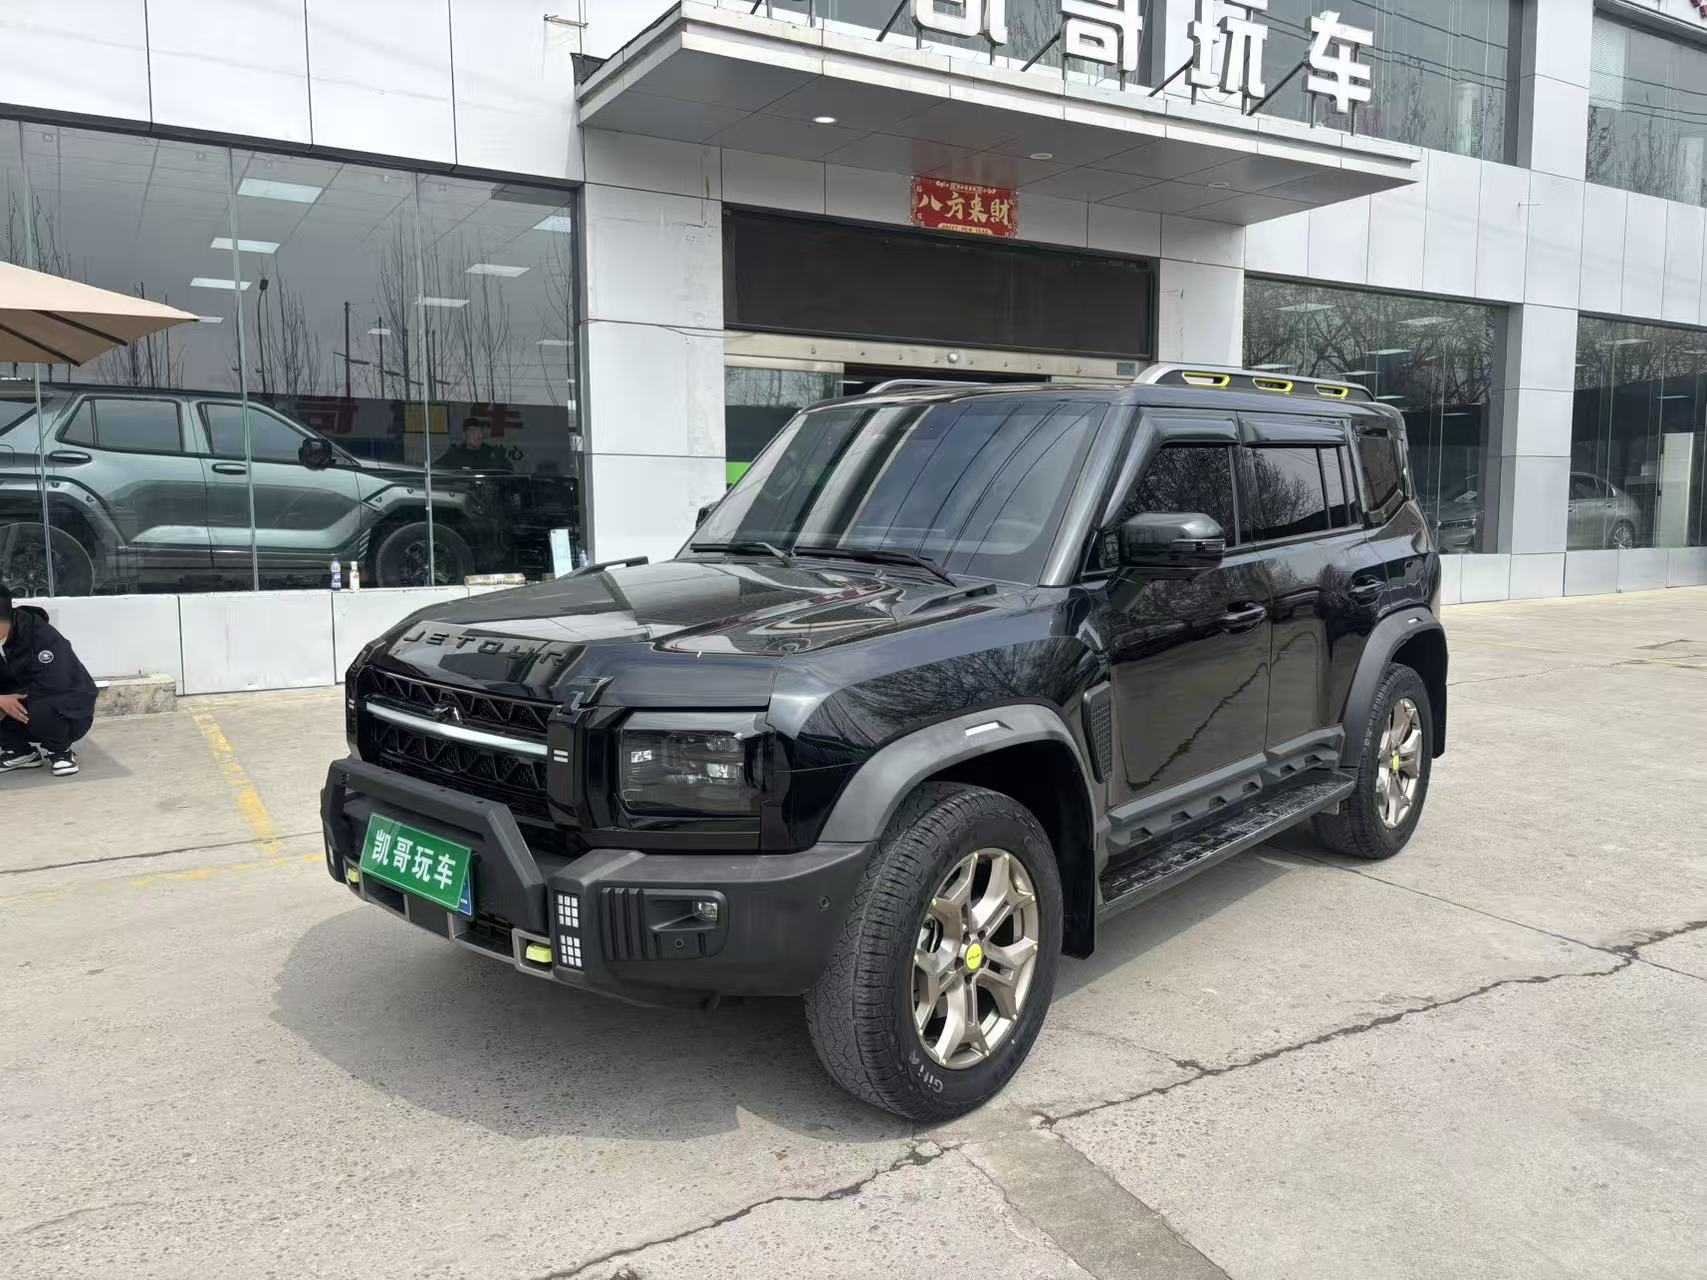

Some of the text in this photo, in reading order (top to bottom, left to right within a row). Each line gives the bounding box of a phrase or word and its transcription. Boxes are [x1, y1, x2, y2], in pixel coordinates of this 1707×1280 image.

[403, 630, 566, 667] JETOUR
[371, 829, 456, 889] 凯哥玩车
[918, 1064, 943, 1093] Giti
